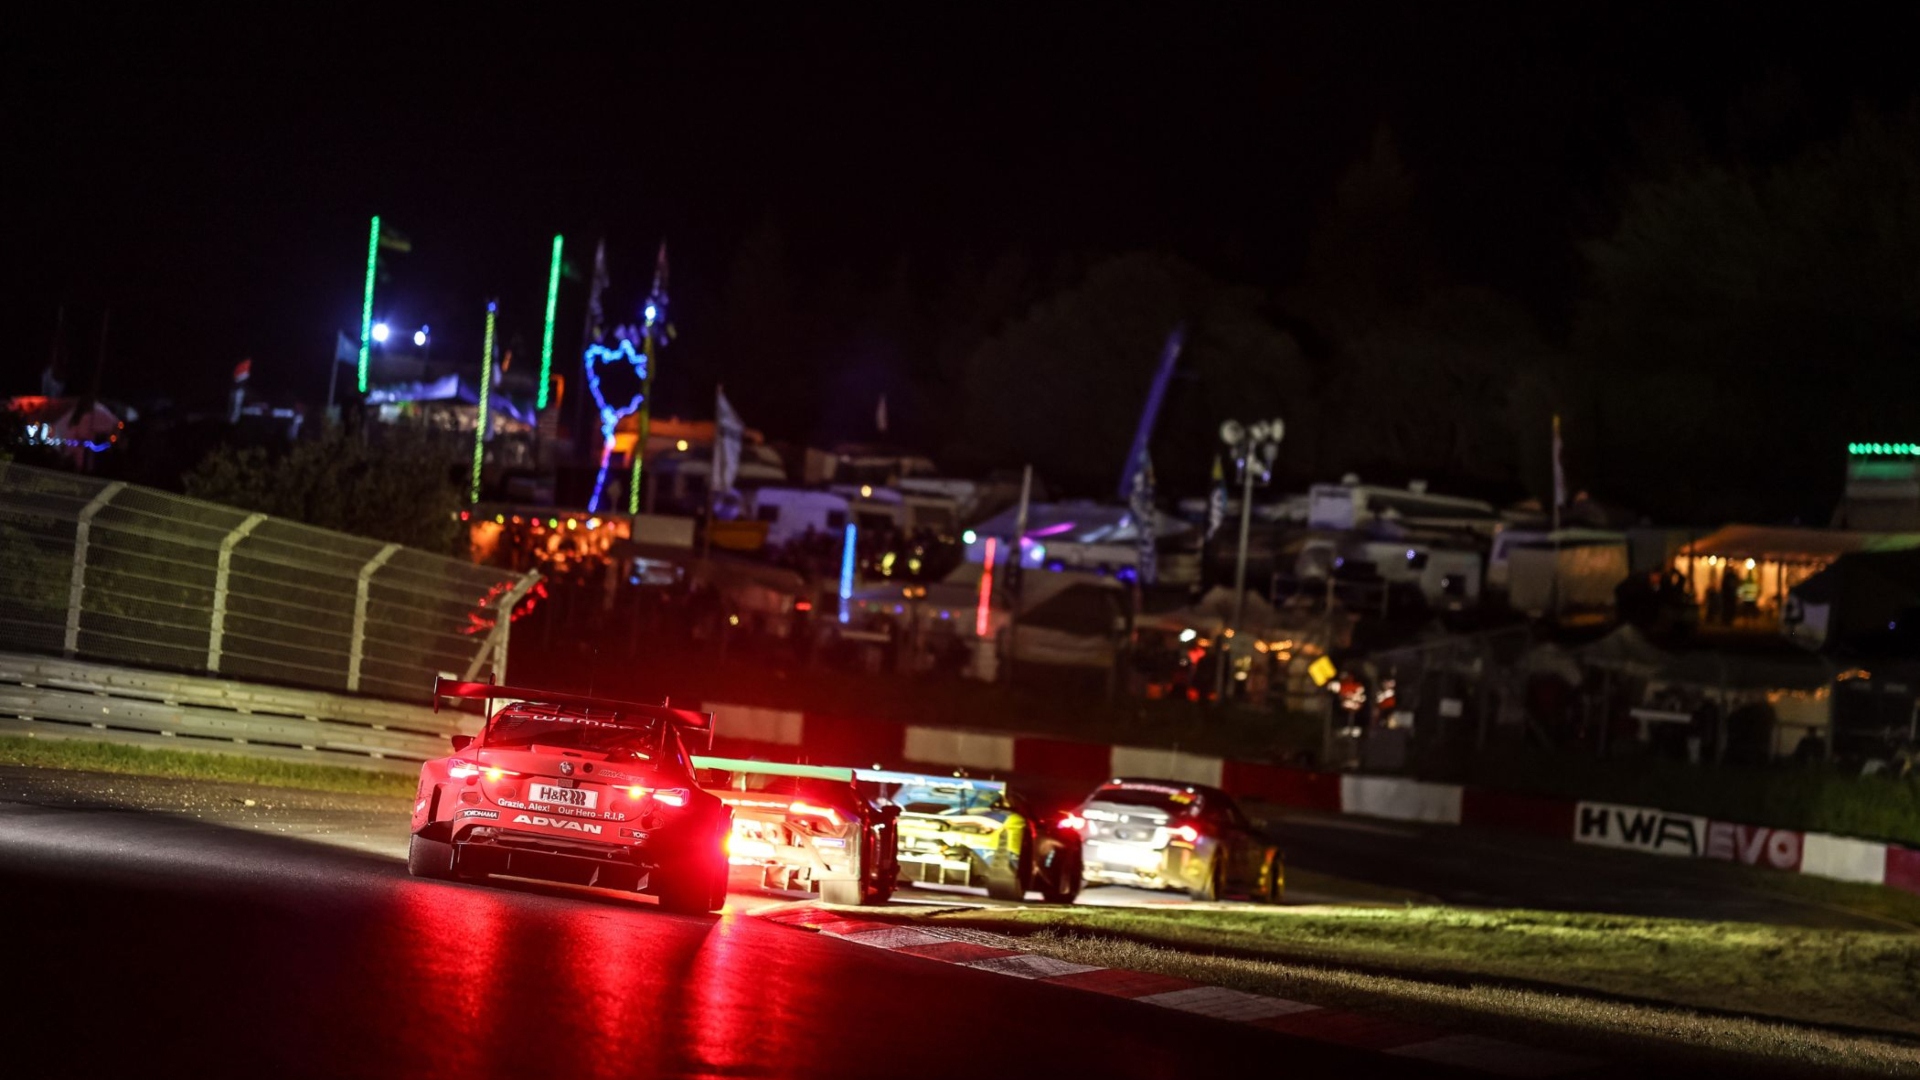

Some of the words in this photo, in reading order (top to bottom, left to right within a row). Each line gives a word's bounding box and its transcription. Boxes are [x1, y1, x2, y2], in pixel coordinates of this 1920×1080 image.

[463, 809, 498, 819] YOKOHAMA
[497, 797, 527, 811] Grazie,
[528, 802, 551, 813] Alex!
[558, 806, 575, 816] Our
[576, 809, 597, 818] Hero
[603, 811, 626, 822] R.I.P.
[512, 814, 603, 835] ADVAN
[1580, 807, 1699, 856] HWA
[1707, 821, 1800, 869] EVO
